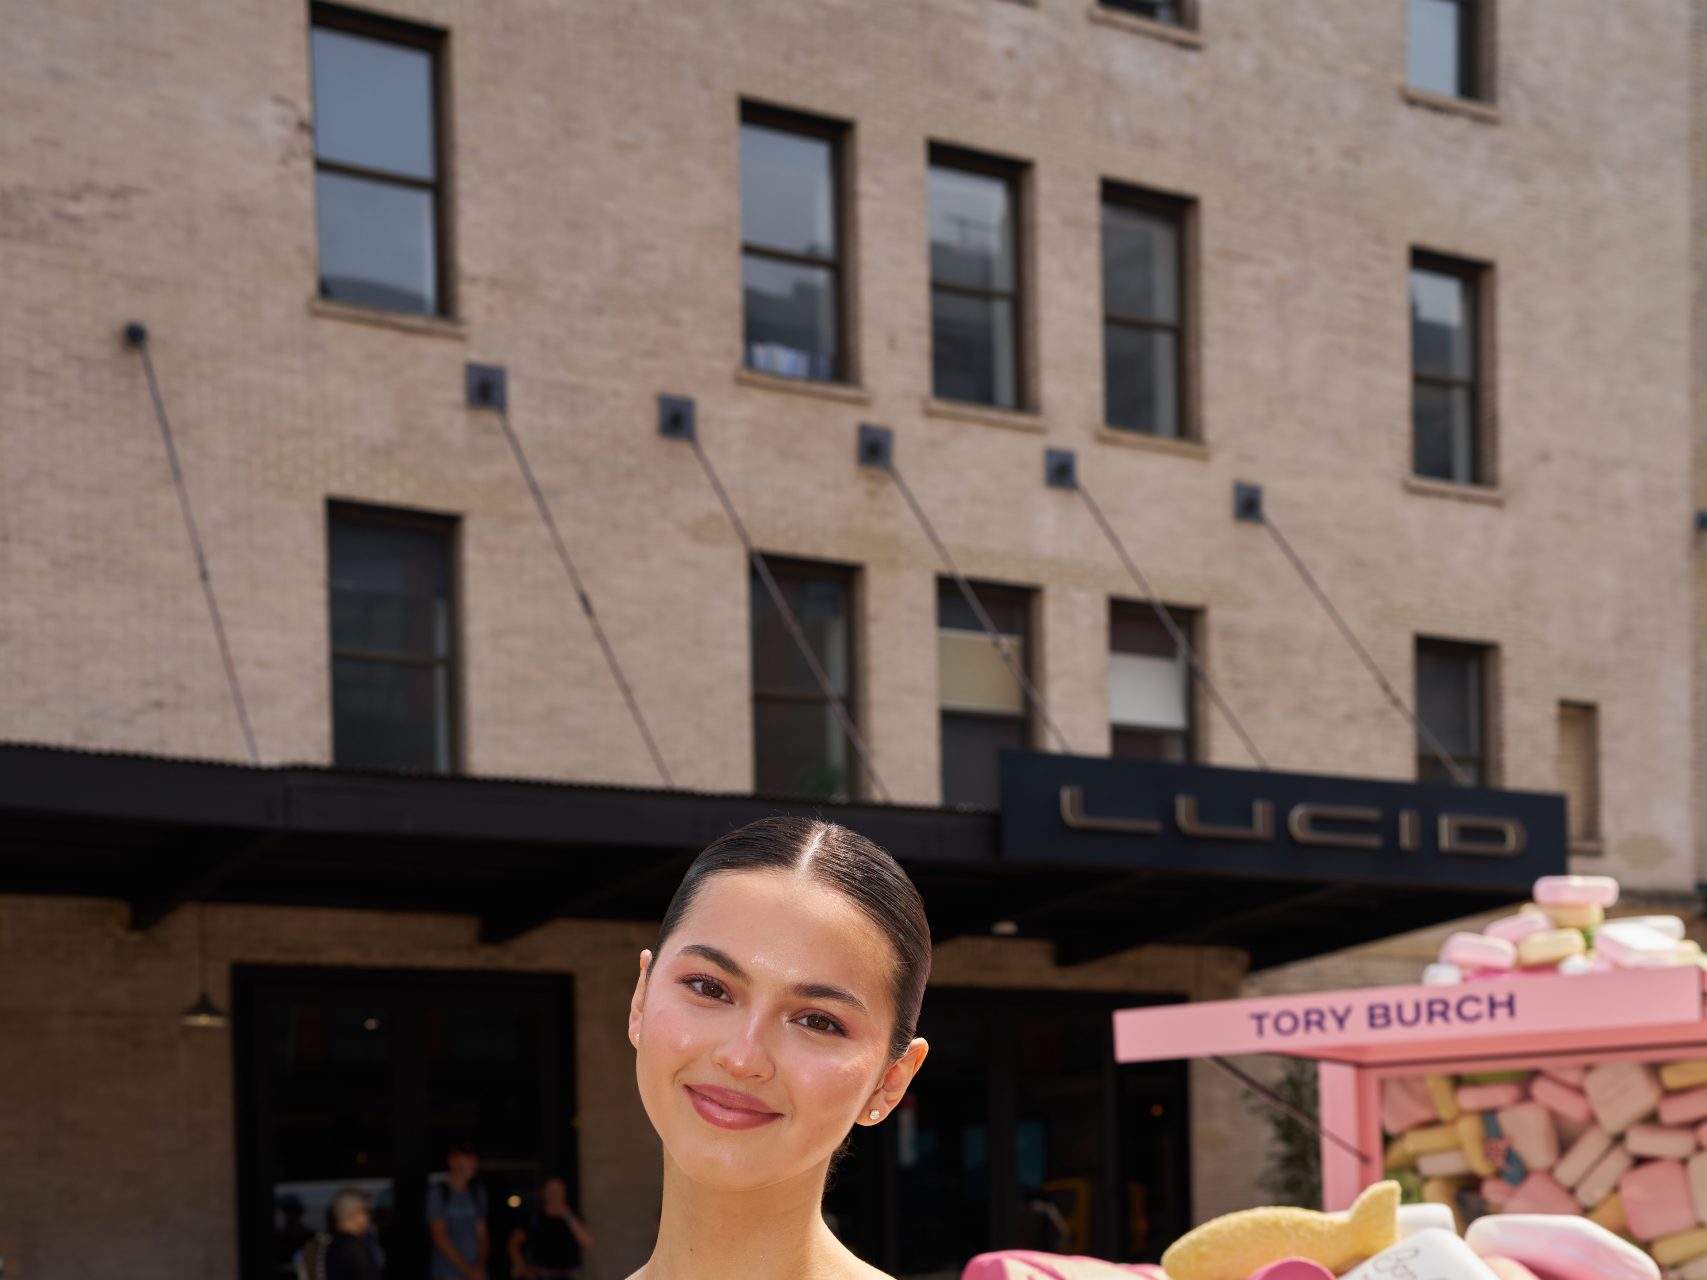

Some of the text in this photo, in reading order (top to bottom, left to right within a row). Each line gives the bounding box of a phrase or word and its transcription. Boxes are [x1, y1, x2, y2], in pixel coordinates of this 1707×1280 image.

[1060, 785, 1526, 855] LUCID
[1249, 991, 1517, 1037] TORY BURCH
